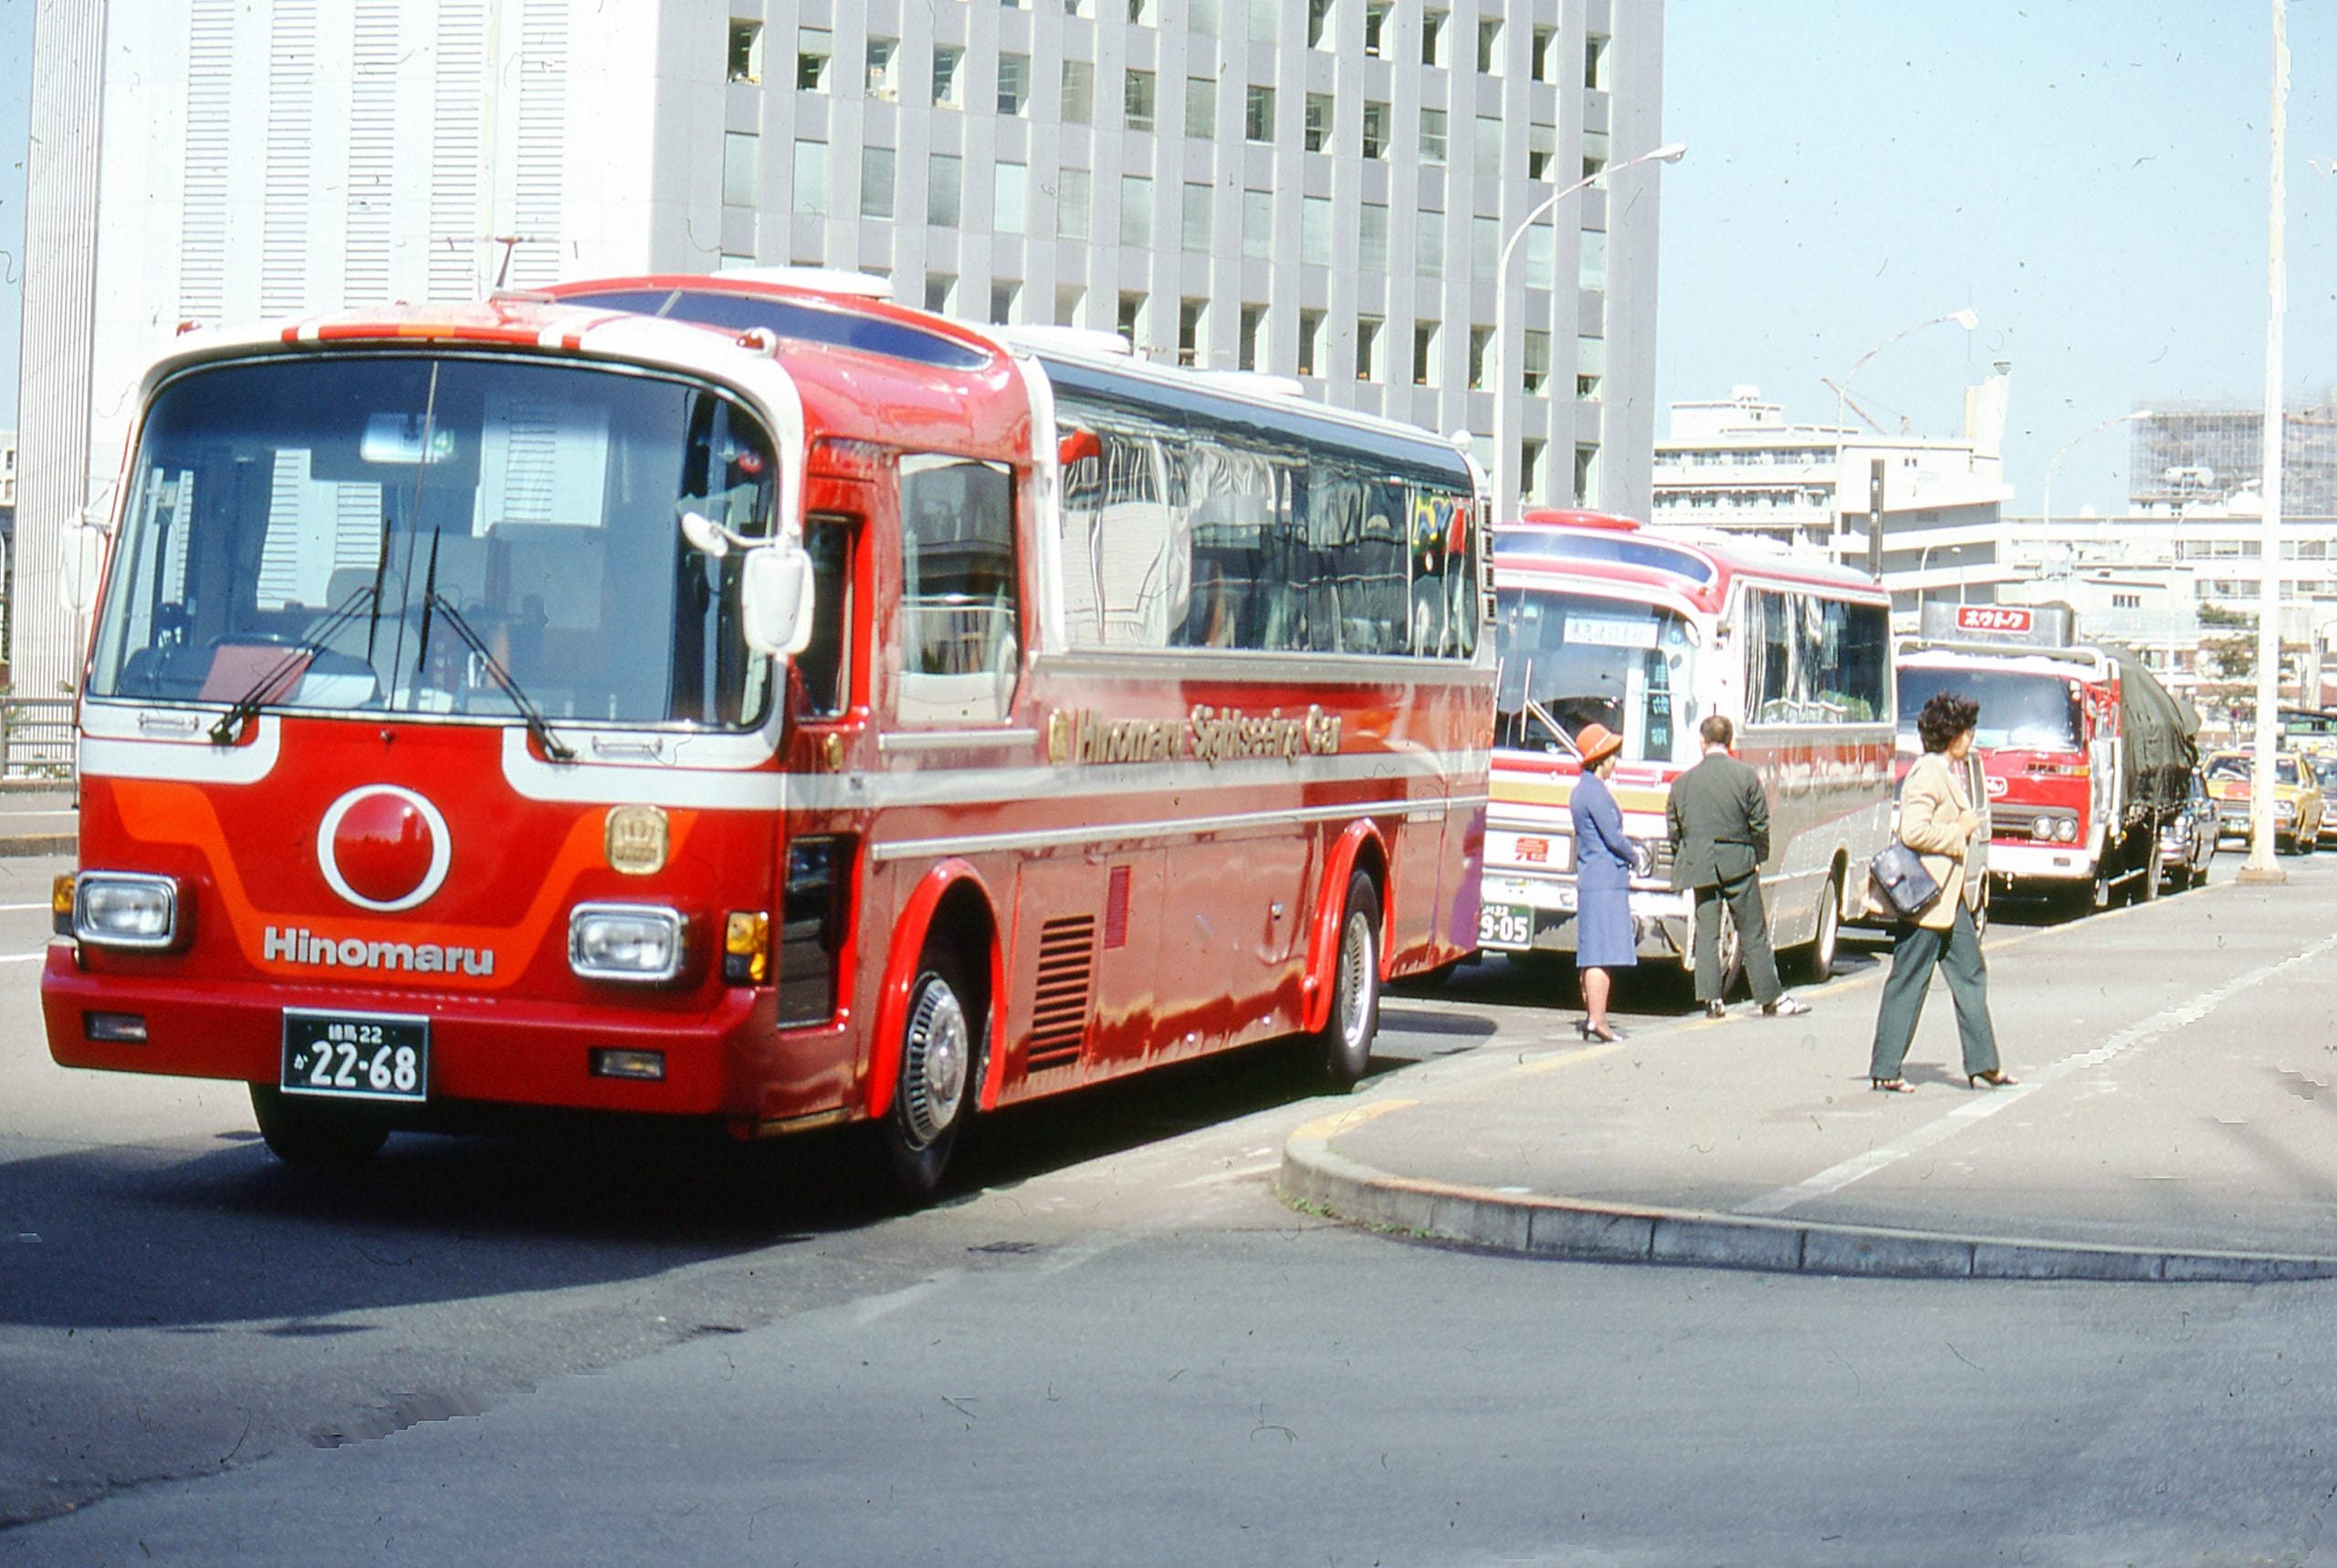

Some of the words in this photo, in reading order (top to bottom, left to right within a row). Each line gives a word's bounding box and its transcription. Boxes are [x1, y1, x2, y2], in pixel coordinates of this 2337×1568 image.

[1965, 609, 2024, 629] ホウトク
[1190, 704, 1302, 768] Sightseeing
[1305, 704, 1342, 756] Car
[263, 925, 494, 976] Hinomaru
